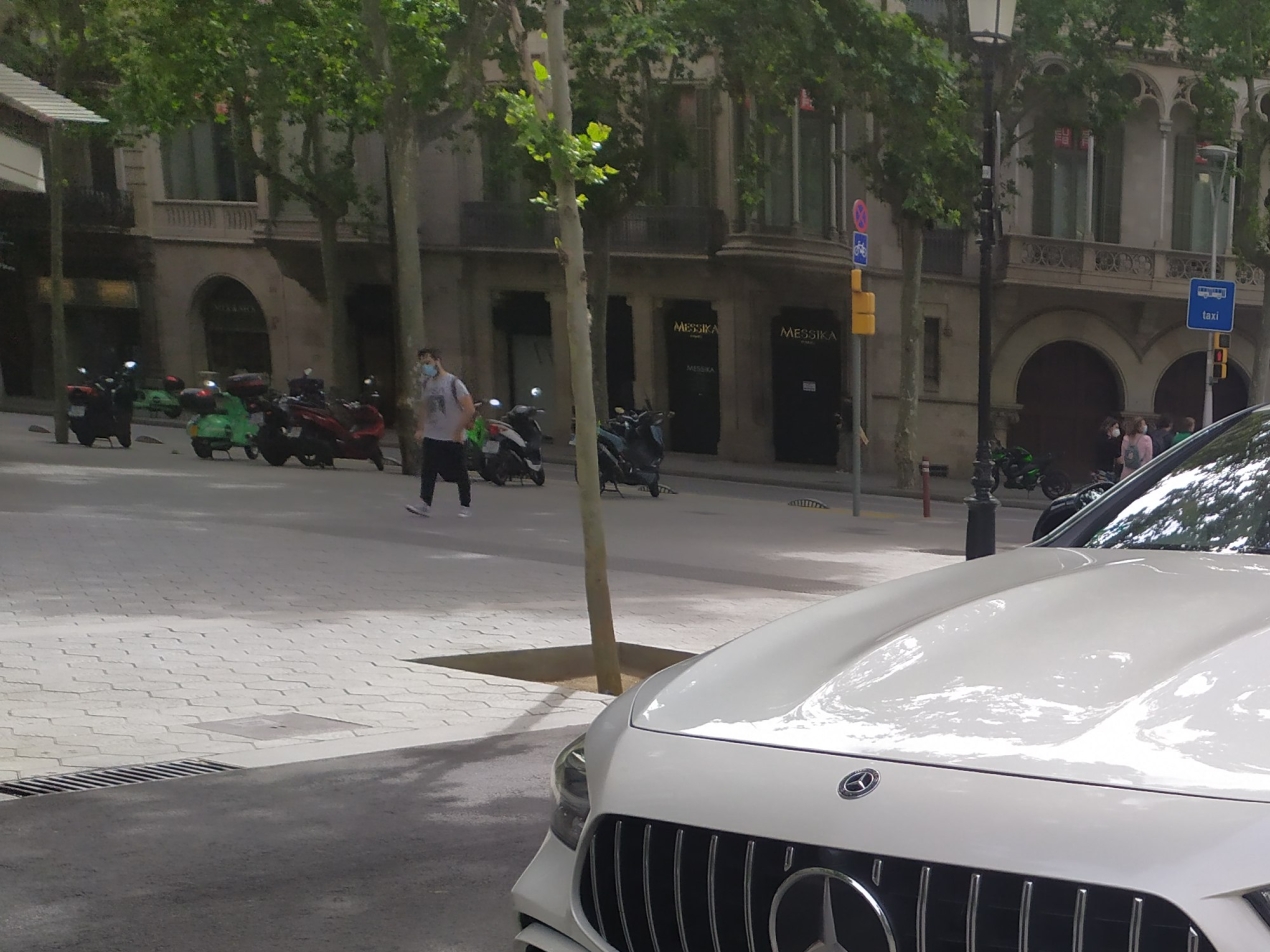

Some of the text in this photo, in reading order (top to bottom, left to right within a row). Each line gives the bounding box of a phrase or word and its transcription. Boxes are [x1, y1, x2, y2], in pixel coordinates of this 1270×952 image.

[1202, 310, 1219, 320] taxi
[673, 321, 719, 335] MESSIKA
[780, 326, 838, 341] MESSIKA
[686, 364, 715, 373] MESSIKA
